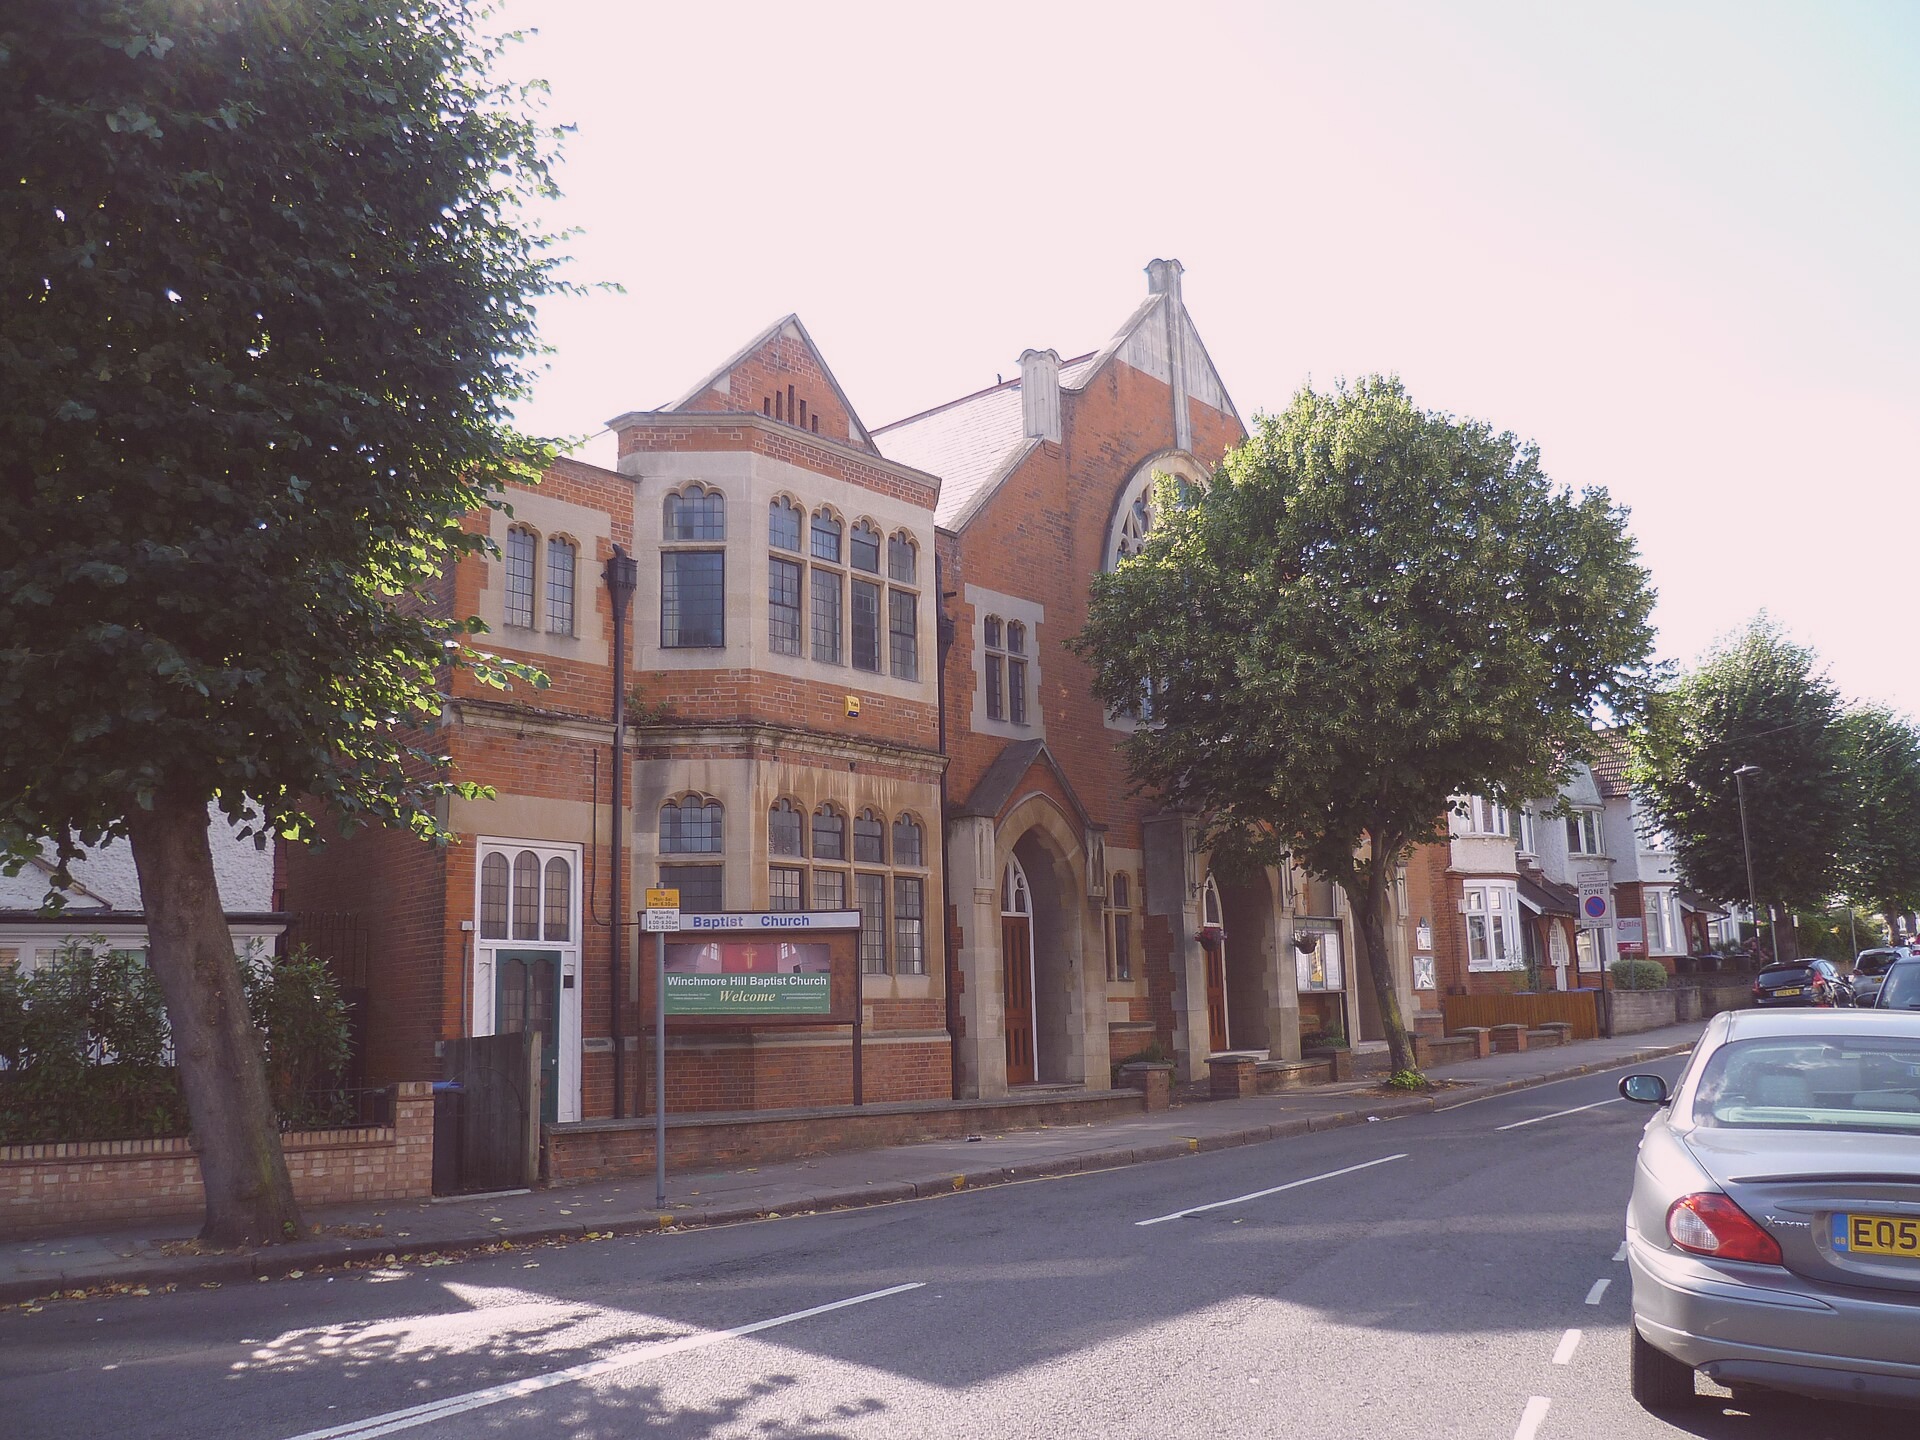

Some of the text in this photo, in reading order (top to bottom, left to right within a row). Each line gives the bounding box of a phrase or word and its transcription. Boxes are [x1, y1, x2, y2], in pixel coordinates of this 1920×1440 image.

[693, 916, 810, 929] Baptist Church
[667, 976, 827, 988] Winchmore Hill Baptist Church
[719, 990, 776, 1002] Welcome
